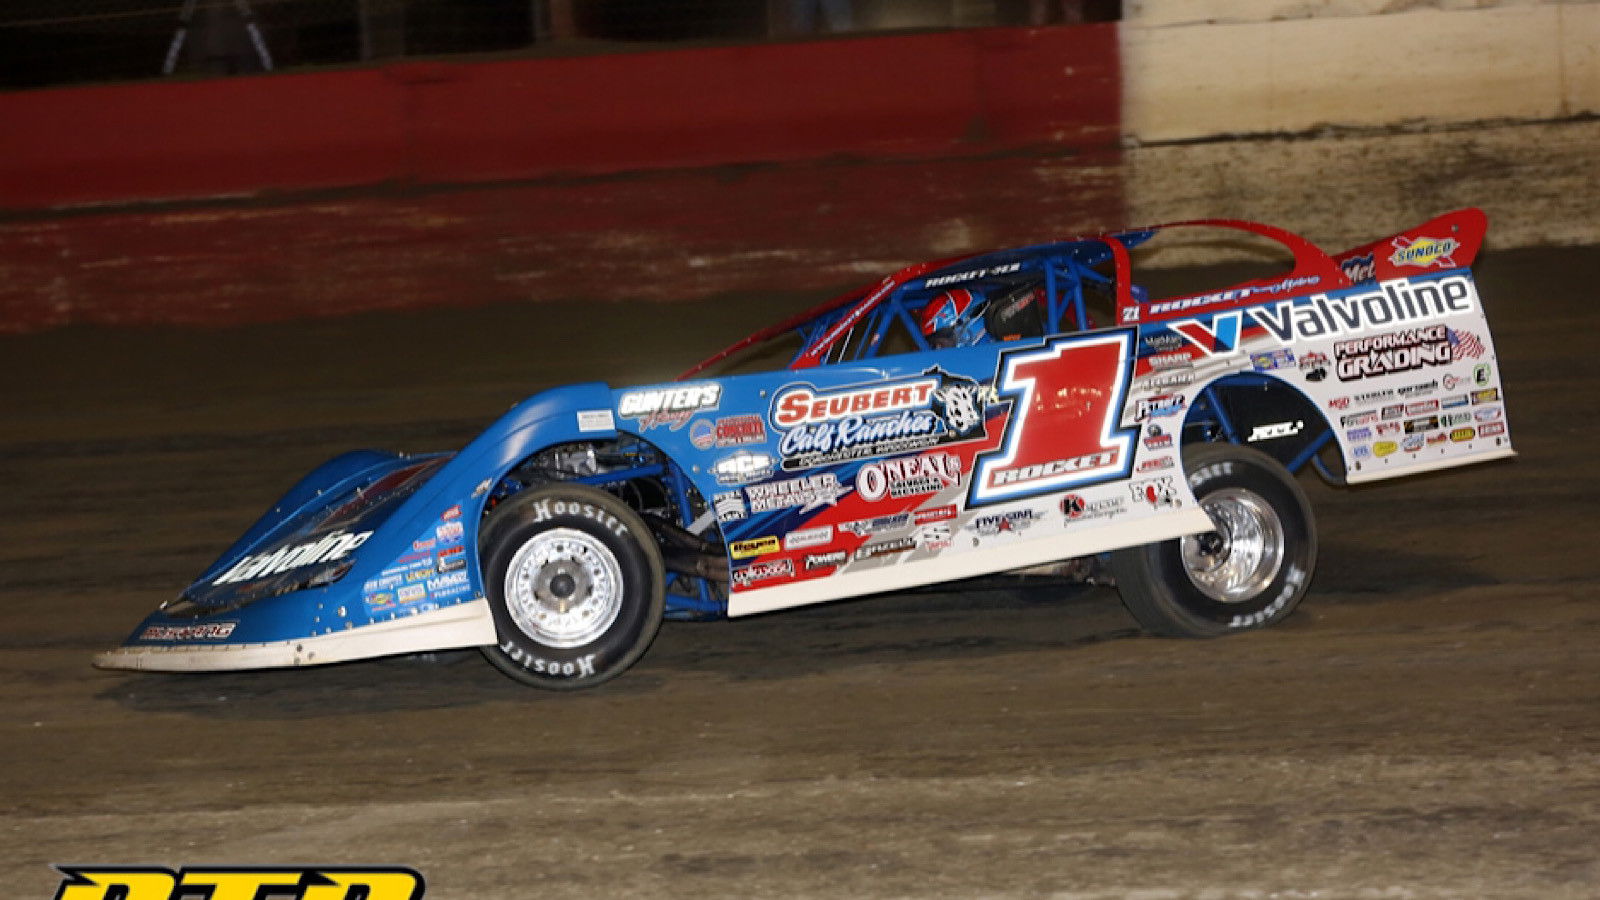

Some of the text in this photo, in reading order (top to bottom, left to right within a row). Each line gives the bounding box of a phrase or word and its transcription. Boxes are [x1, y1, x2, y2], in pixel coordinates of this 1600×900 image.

[1397, 241, 1451, 262] SUNOCO
[1254, 281, 1470, 342] Valvoline
[1334, 325, 1449, 359] PERFORMANCE
[1337, 341, 1452, 382] GRADING
[619, 383, 721, 417] GUNTER'S
[777, 382, 934, 425] SEUBERT
[972, 331, 1132, 502] 1
[782, 410, 934, 455] Calf Ranches
[991, 452, 1118, 486] ROCKET
[745, 474, 836, 499] WHEELER
[975, 515, 1001, 529] FIVE
